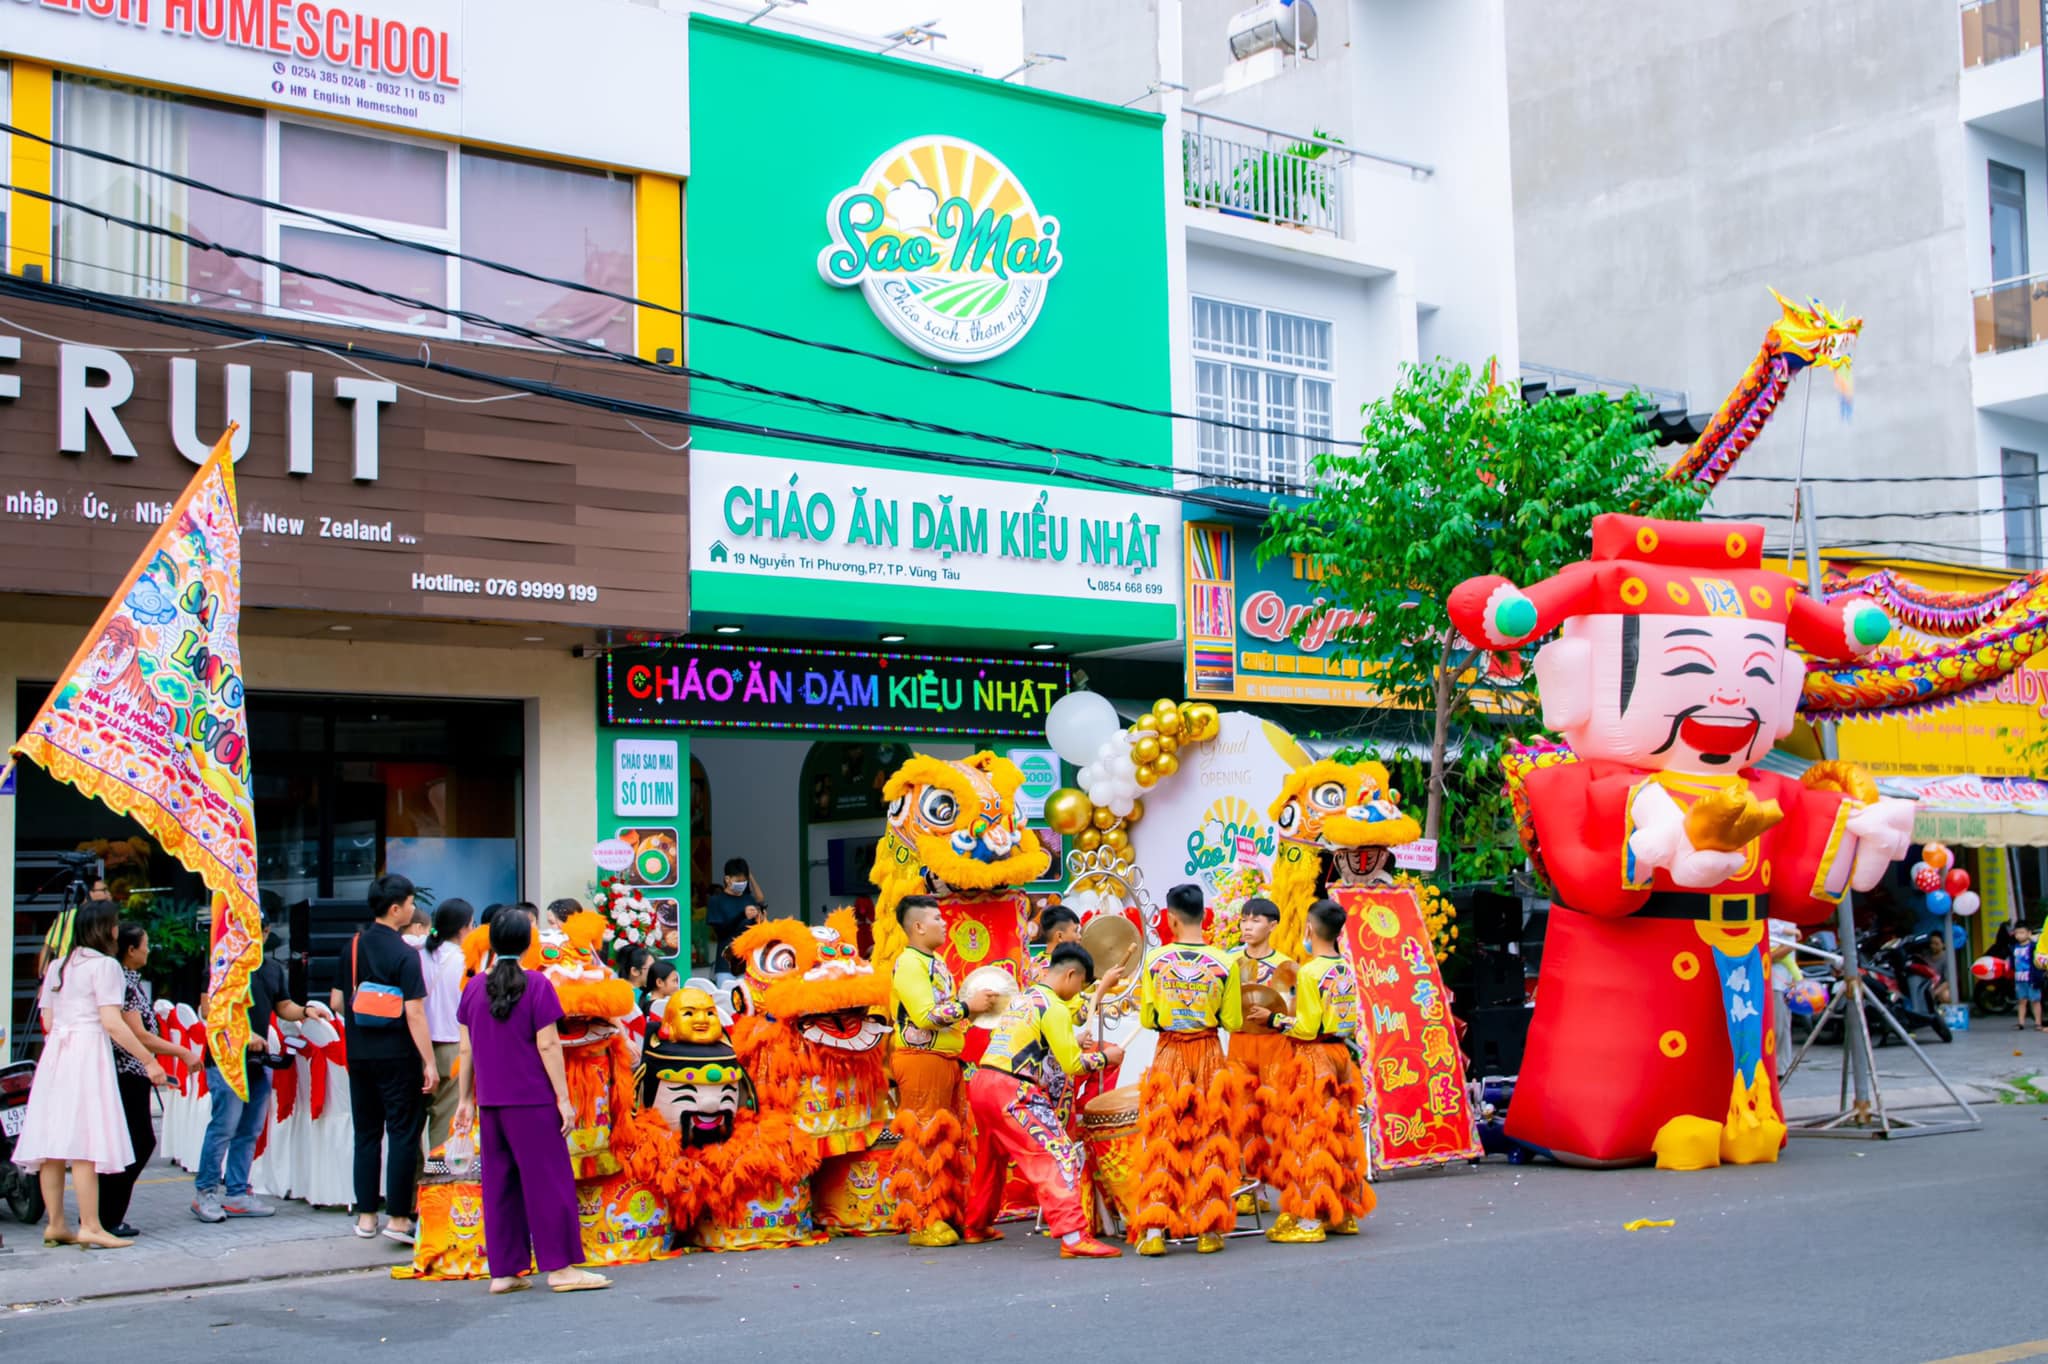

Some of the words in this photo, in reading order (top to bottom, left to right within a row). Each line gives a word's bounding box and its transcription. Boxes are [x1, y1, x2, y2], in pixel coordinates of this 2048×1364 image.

[290, 84, 307, 98] HM
[313, 88, 351, 106] English
[356, 96, 419, 118] Homeschool
[291, 65, 316, 80] 0254
[319, 71, 339, 84] 385
[341, 75, 366, 89] 0248
[376, 81, 401, 97] 0932
[418, 89, 431, 102] 05
[433, 91, 445, 105] 03
[829, 193, 940, 280] Sao
[936, 196, 1058, 281] Mai
[883, 279, 920, 324] Cháo
[6, 490, 59, 521] nhập
[83, 492, 118, 524] Úc,
[263, 512, 305, 536] New
[319, 516, 392, 543] Zealand
[723, 472, 836, 543] CHÁO
[847, 486, 899, 547] ĂN
[912, 494, 990, 560] DẶM
[1000, 490, 1070, 562] KIỂU
[1080, 511, 1161, 575] NHẬT
[733, 552, 745, 565] 19
[750, 553, 795, 570] Nguyễn
[909, 565, 937, 582] Vũng
[941, 567, 961, 581] Tàu
[411, 572, 481, 594] Hotline:
[485, 577, 518, 597] 076
[521, 580, 566, 600] 9999
[568, 583, 598, 602] 199
[1097, 580, 1122, 593] 0854
[1125, 582, 1143, 594] 668
[1145, 583, 1163, 595] 699
[626, 657, 735, 703] CHÁO
[742, 659, 793, 705] ĂN
[1975, 664, 2048, 719] aby
[643, 753, 657, 770] SAO
[659, 753, 673, 771] MAI
[1200, 769, 1252, 787] OPENING
[621, 772, 637, 806] SỐ
